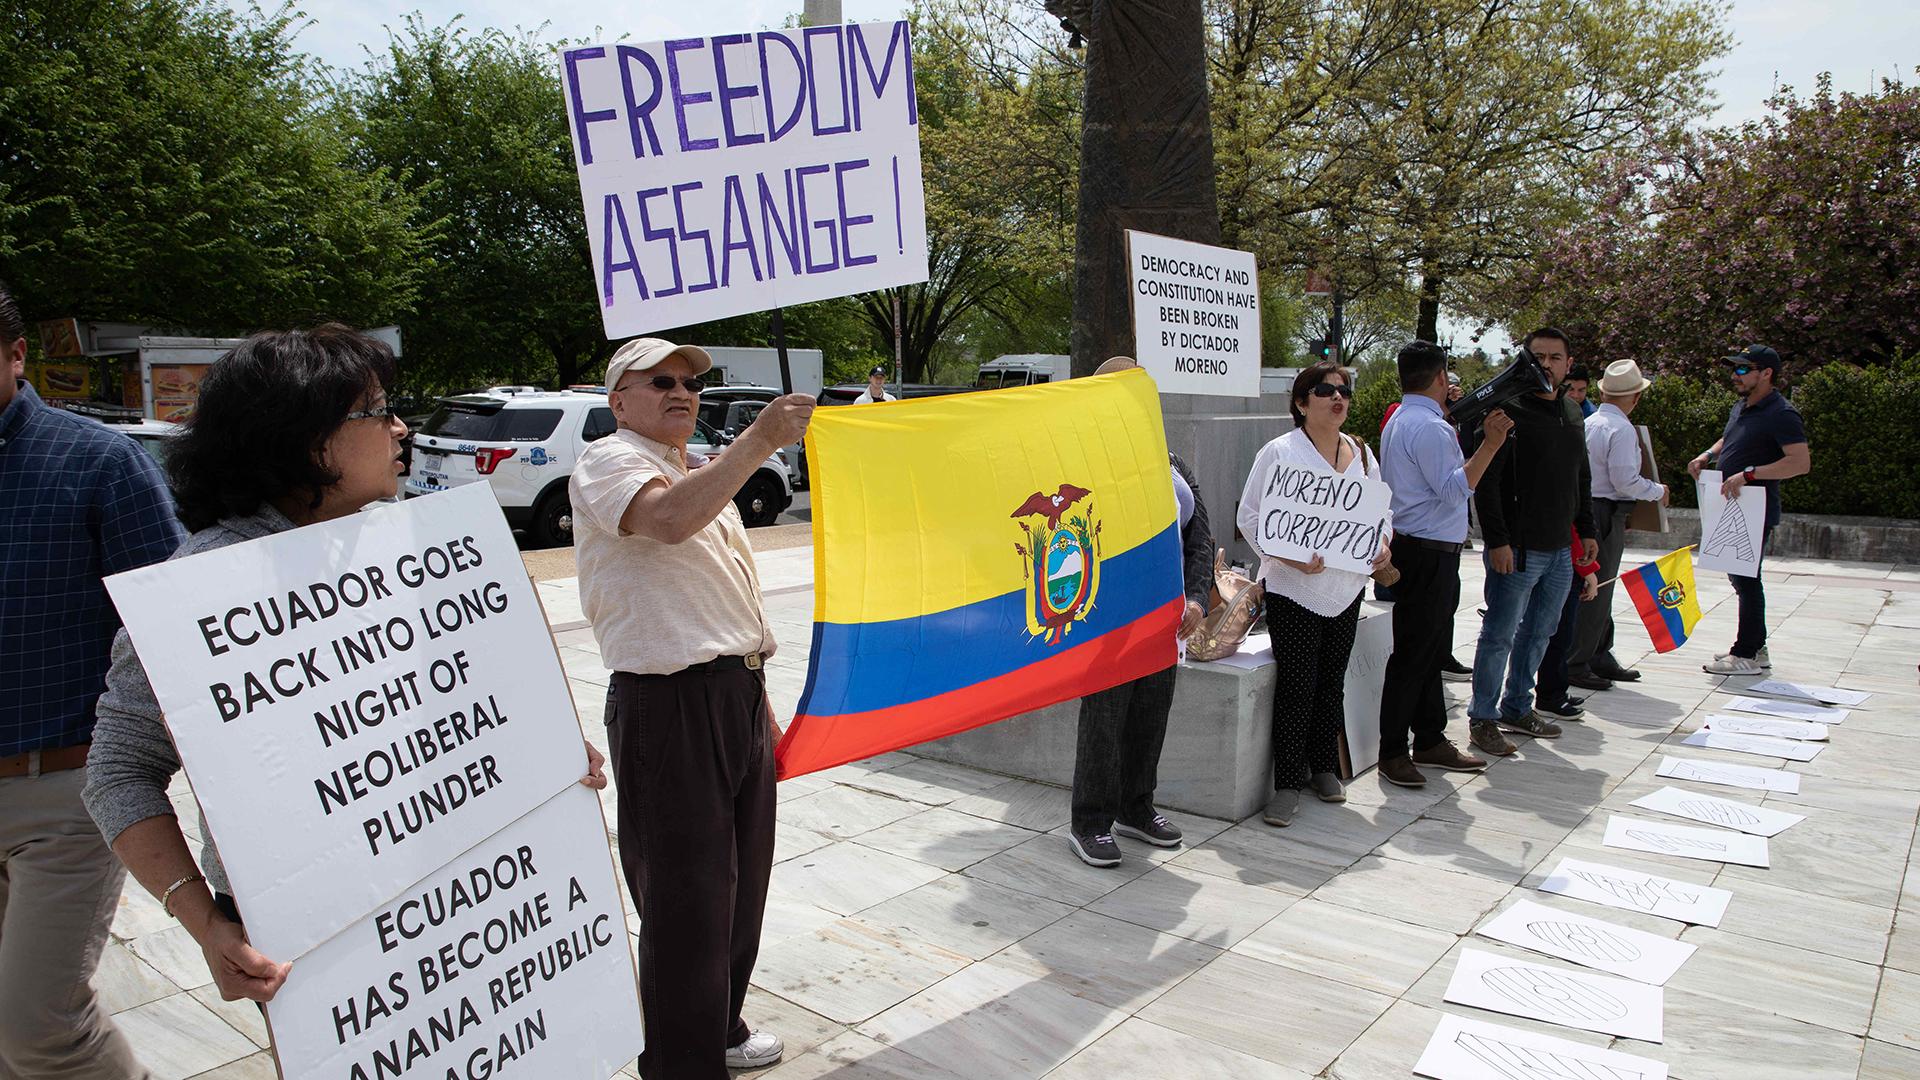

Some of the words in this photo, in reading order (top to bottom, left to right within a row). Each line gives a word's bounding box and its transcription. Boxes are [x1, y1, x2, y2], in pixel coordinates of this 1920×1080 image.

[564, 20, 917, 165] FREEDOM
[1138, 278, 1224, 305] CONSTITUTION
[1227, 294, 1256, 309] HAVE
[1141, 254, 1221, 282] DEMOCRACY
[1224, 268, 1249, 286] AND
[1160, 306, 1190, 324] BEEN
[1194, 310, 1239, 330] BROKEN
[1161, 331, 1176, 347] BY
[1180, 332, 1239, 353] DICTADOR
[1175, 357, 1228, 375] MORENO
[1264, 508, 1385, 566] CORRUPTO!
[1265, 464, 1363, 511] MORENO
[198, 566, 393, 656] ECUADOR
[396, 535, 483, 588] GOES
[209, 648, 330, 723] BACK
[332, 616, 415, 675] INTO
[420, 581, 508, 640] LONG
[313, 671, 422, 748] NIGHT
[430, 650, 471, 694] OF
[313, 694, 508, 815] NEOLIBERAL
[363, 754, 503, 856] PLUNDER
[374, 845, 538, 953] ECUADOR
[332, 971, 409, 1045] HAS
[418, 892, 552, 995] BECOME
[568, 876, 587, 912] A
[488, 913, 613, 1014] REPUBLIC
